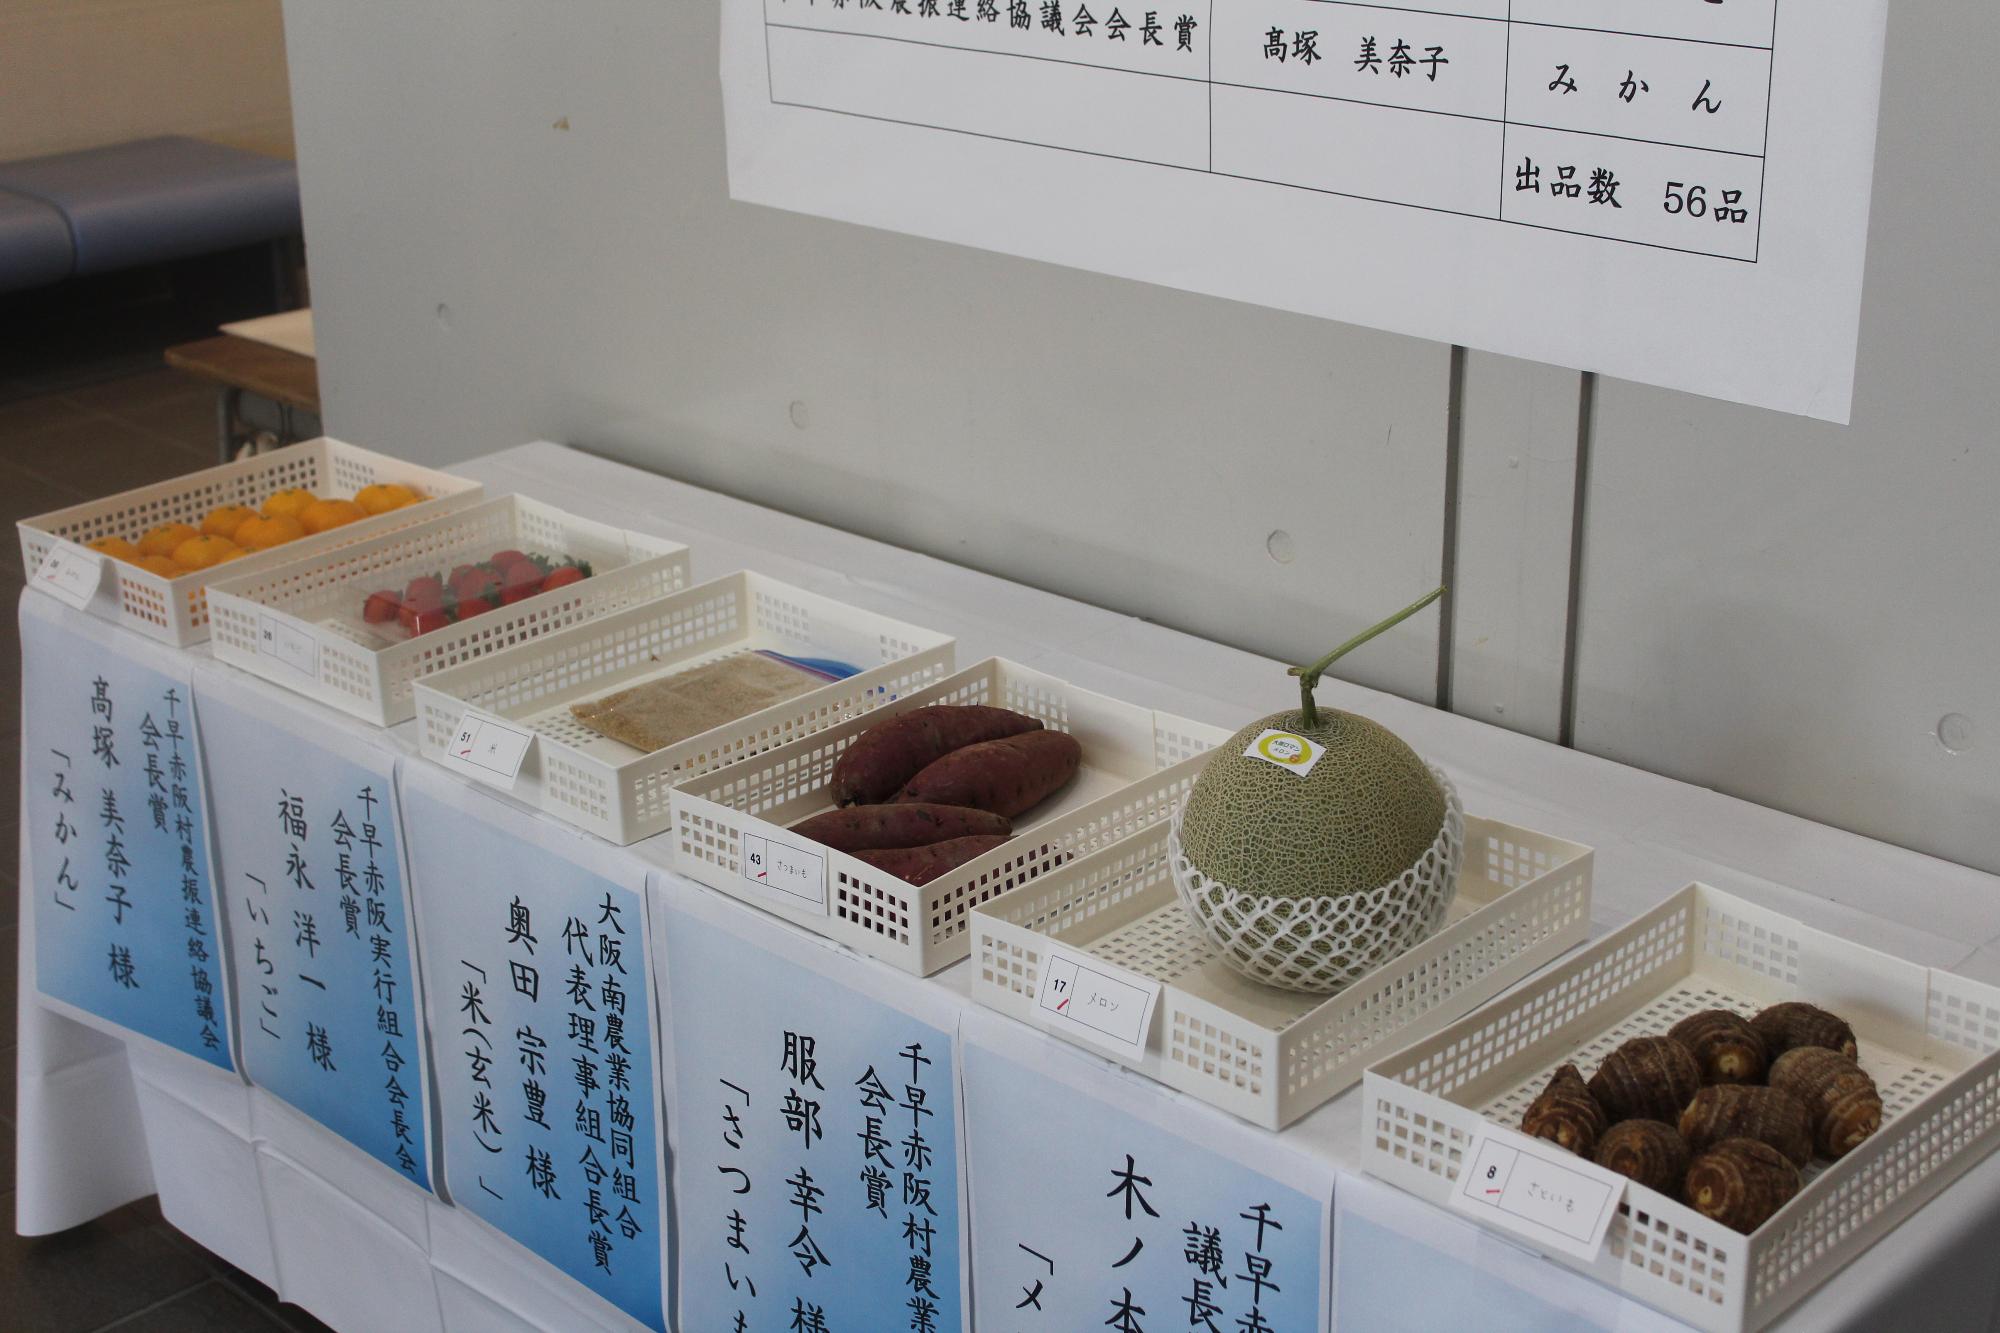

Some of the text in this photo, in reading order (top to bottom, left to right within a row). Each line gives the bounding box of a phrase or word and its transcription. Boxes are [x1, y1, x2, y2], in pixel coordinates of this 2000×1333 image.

[780, 0, 1198, 53] 振連絡協議会会長賞
[1354, 36, 1449, 82] 美奈子
[1515, 156, 1748, 224] 出品数 56品
[139, 712, 169, 834] 会長賞
[460, 731, 471, 743] 51
[100, 787, 132, 925] 美奈子
[163, 688, 220, 1051] 千早赤阪村農振連絡協議会
[330, 809, 361, 940] 会長賞
[750, 852, 761, 865] 43
[108, 943, 140, 989] 様
[278, 788, 315, 890] 福永
[306, 1022, 336, 1071] 様
[357, 785, 417, 1176] 千早赤阪実行組合会長会
[1054, 978, 1119, 1012] 17 メロン
[505, 895, 562, 1200] 奥田 宗豊 様
[561, 916, 612, 1276] 代表理事組合長賞
[597, 892, 642, 1240] 大阪南農業協同組合
[780, 1030, 825, 1150] 服部
[855, 1064, 895, 1219] 会長賞
[898, 1043, 941, 1333] 千早赤阪村農業
[1487, 1165, 1497, 1179] 8
